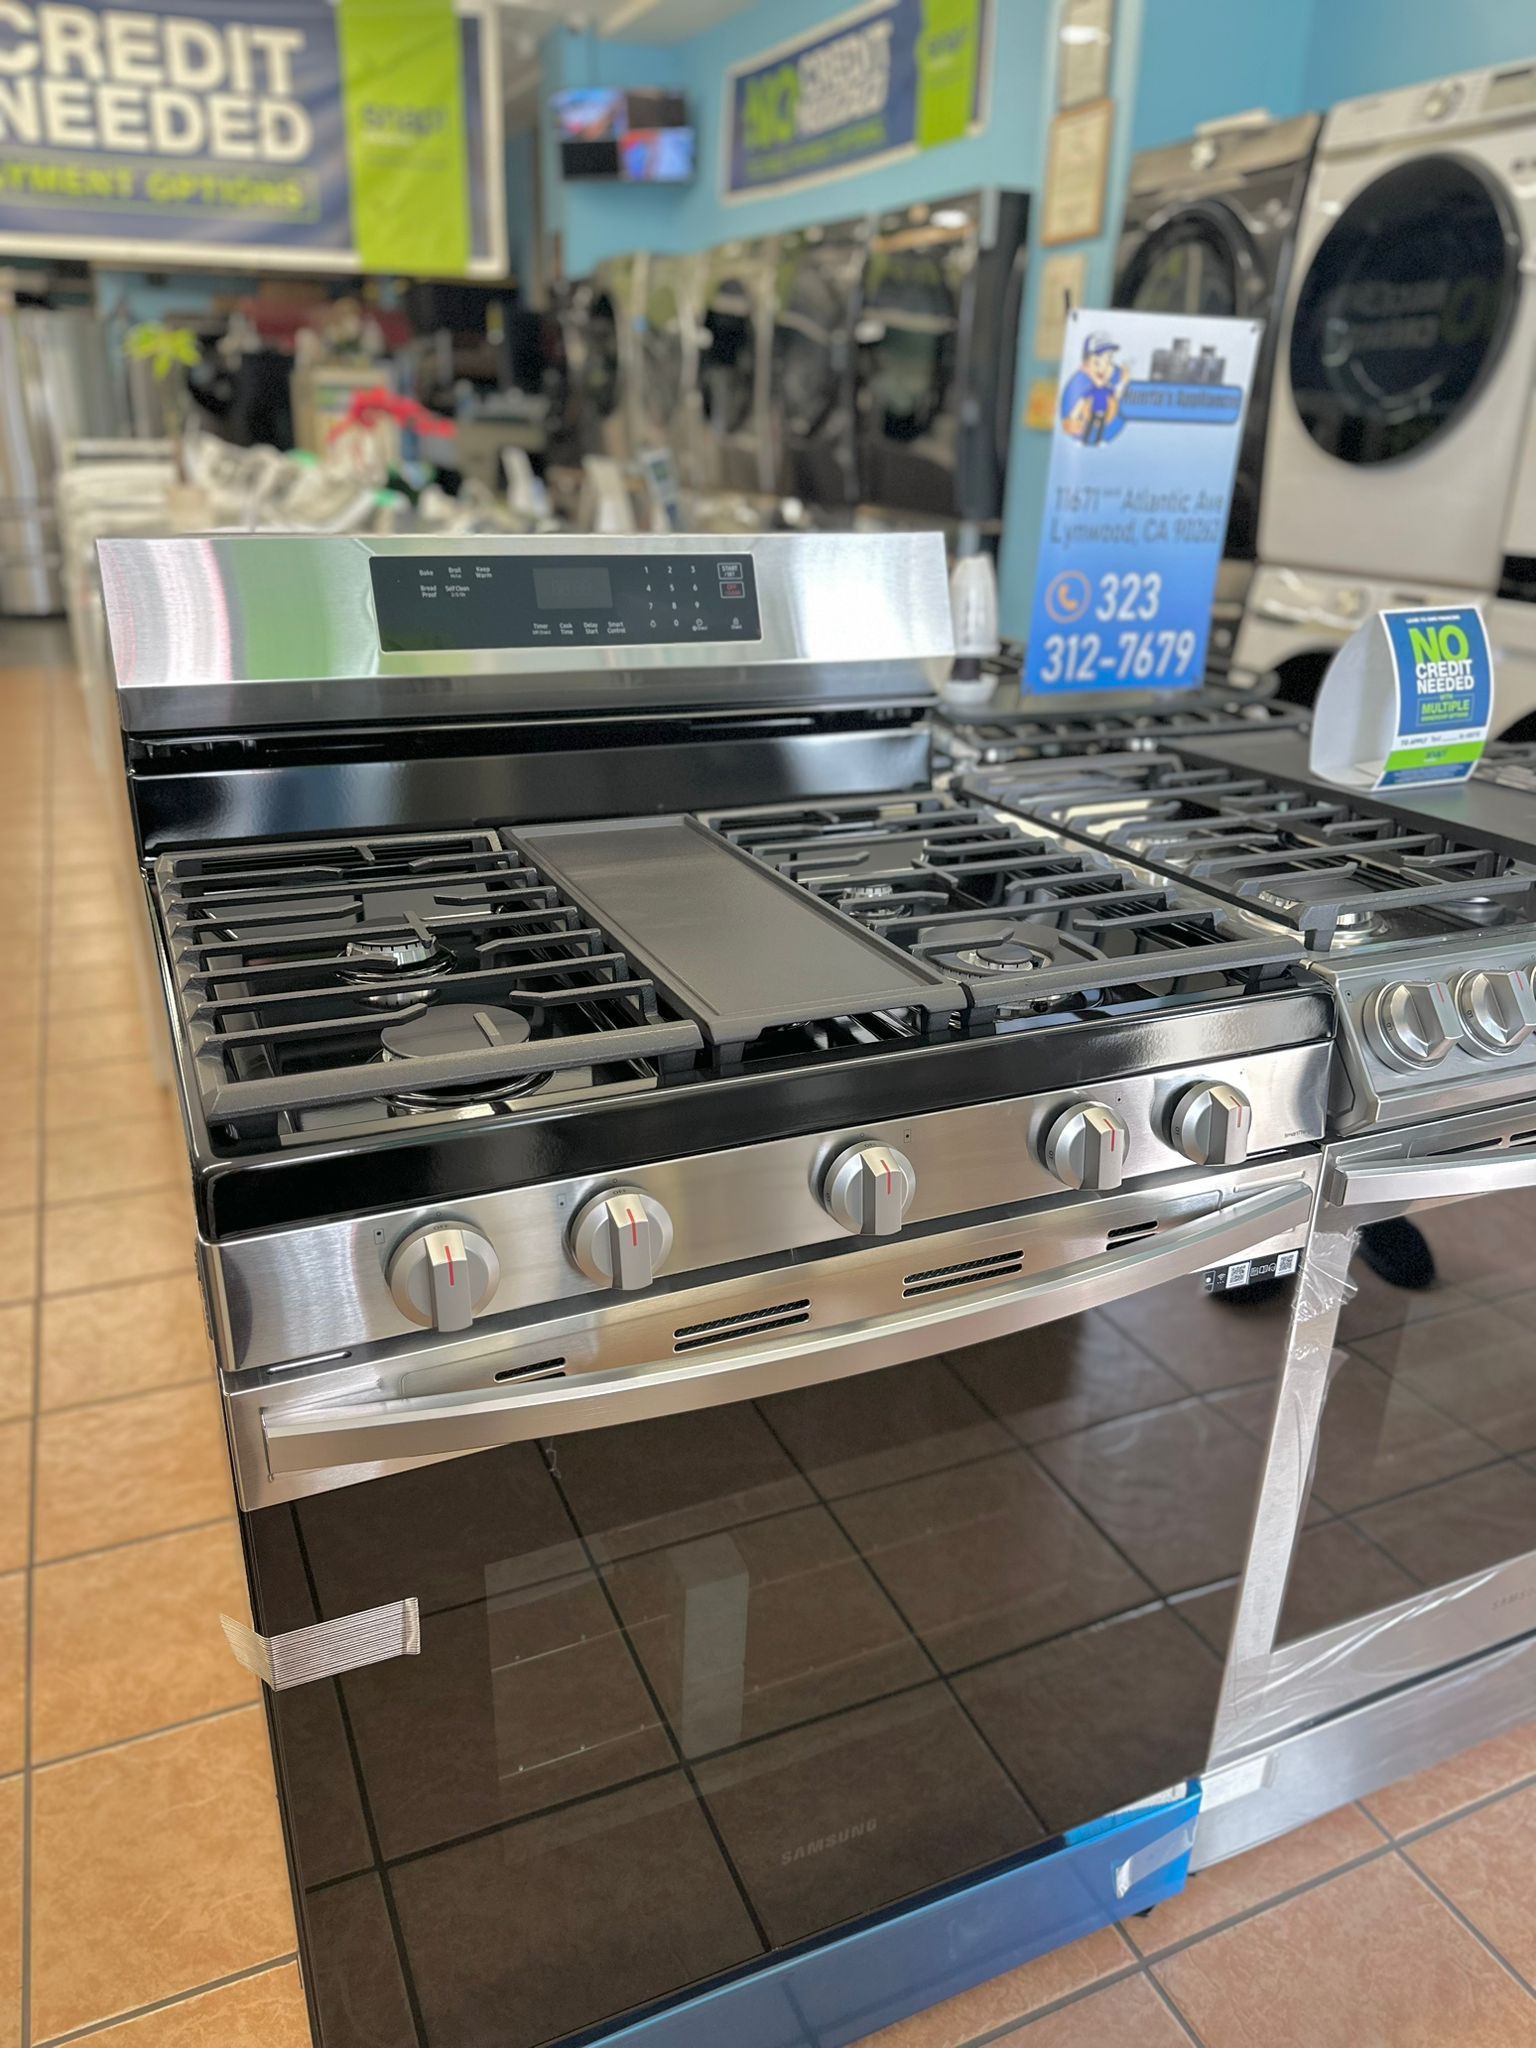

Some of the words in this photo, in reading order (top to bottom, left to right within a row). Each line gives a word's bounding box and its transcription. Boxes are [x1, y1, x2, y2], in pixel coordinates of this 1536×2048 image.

[0, 0, 304, 95] CREDIT
[0, 77, 312, 162] NEEDED
[146, 174, 304, 209] OPTIONS
[1055, 486, 1100, 512] 11671
[1121, 486, 1192, 513] Atlantic
[1194, 487, 1225, 512] Ave
[1142, 519, 1169, 543] CA
[448, 566, 462, 574] Broil
[644, 566, 648, 574] 1
[667, 566, 673, 574] 2
[691, 565, 696, 573] 3
[646, 584, 651, 592] 4
[669, 584, 675, 592] 5
[1095, 571, 1163, 623] 323
[649, 602, 653, 610] 7
[672, 602, 677, 610] 8
[583, 621, 599, 629] Delay
[673, 619, 679, 627] 0
[1408, 624, 1470, 664] NO
[1040, 630, 1197, 684] 312-7679
[1415, 659, 1474, 680] CREDIT
[1416, 675, 1475, 695] NEEDED
[1422, 700, 1470, 714] MULTIPLE
[781, 1818, 877, 1866] SAMSUNG
